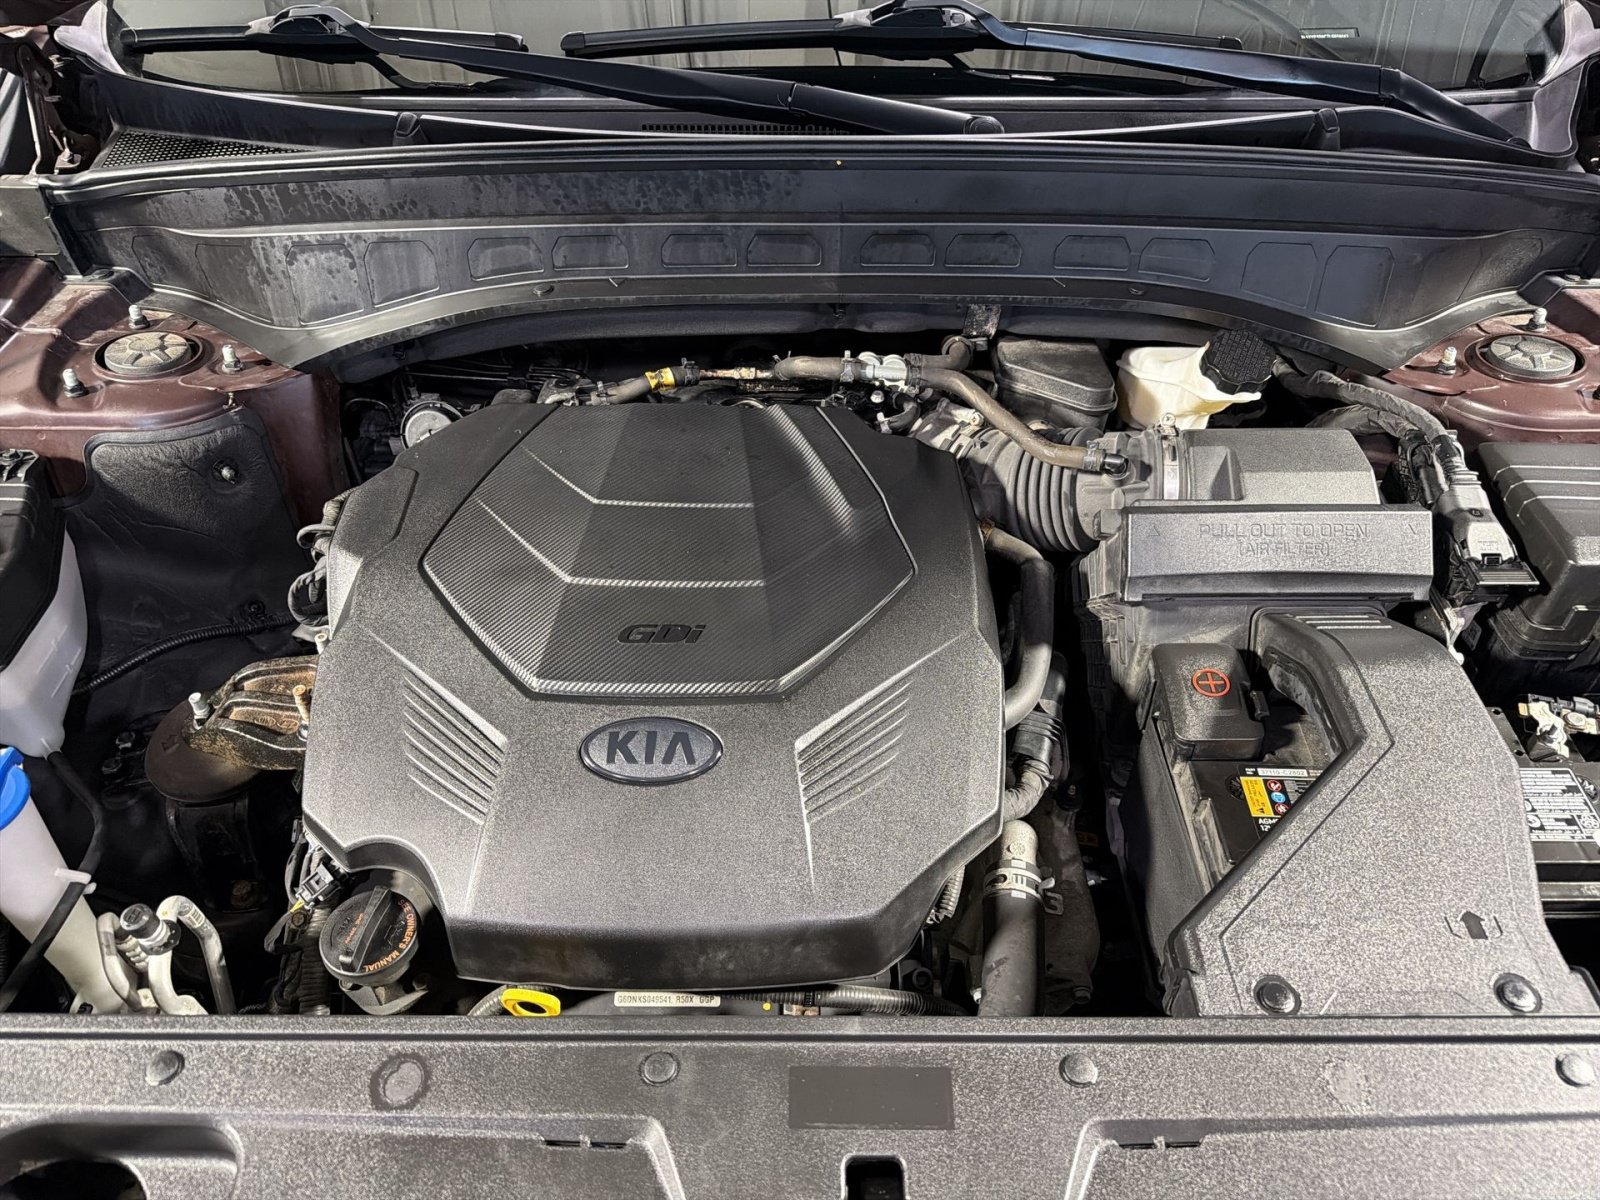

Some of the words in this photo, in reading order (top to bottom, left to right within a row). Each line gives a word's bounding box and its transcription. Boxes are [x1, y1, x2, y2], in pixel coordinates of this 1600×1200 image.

[1198, 523, 1246, 538] PULL
[1249, 522, 1287, 538] OUT
[1291, 522, 1316, 538] TO
[1320, 522, 1370, 538] OPEN
[1239, 542, 1270, 557] (AIR
[1274, 542, 1330, 557] FILTER)
[617, 624, 707, 644] GDi
[606, 730, 697, 766] KIA
[399, 912, 416, 948] OWNER'S
[363, 950, 400, 972] MANUAL
